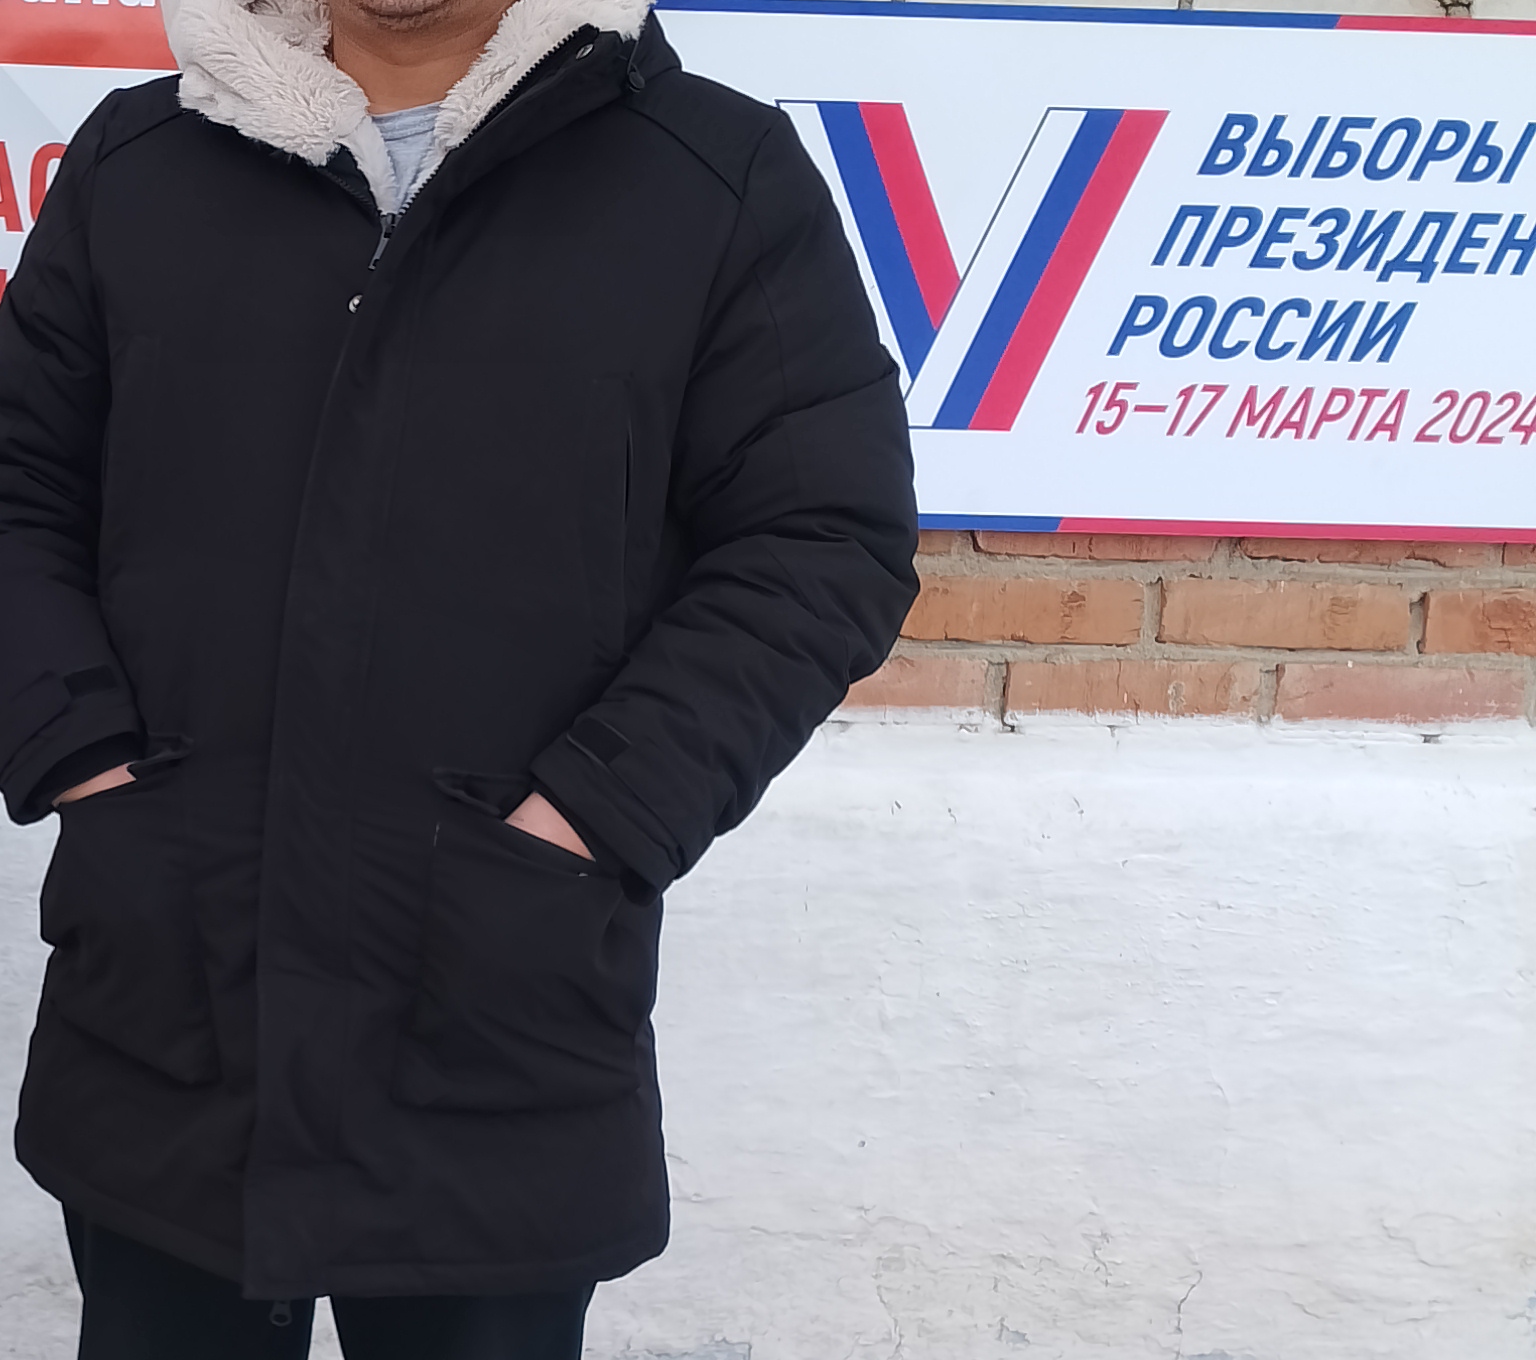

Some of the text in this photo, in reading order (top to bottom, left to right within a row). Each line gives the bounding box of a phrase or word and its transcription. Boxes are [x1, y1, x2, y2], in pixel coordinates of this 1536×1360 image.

[1196, 112, 1536, 185] ВЫБОРЫ
[1150, 203, 1536, 284] ПРЕЗИДЕН
[1106, 294, 1419, 364] РОССИИ
[1075, 380, 1536, 446] 15–17 МАРТА 2024
